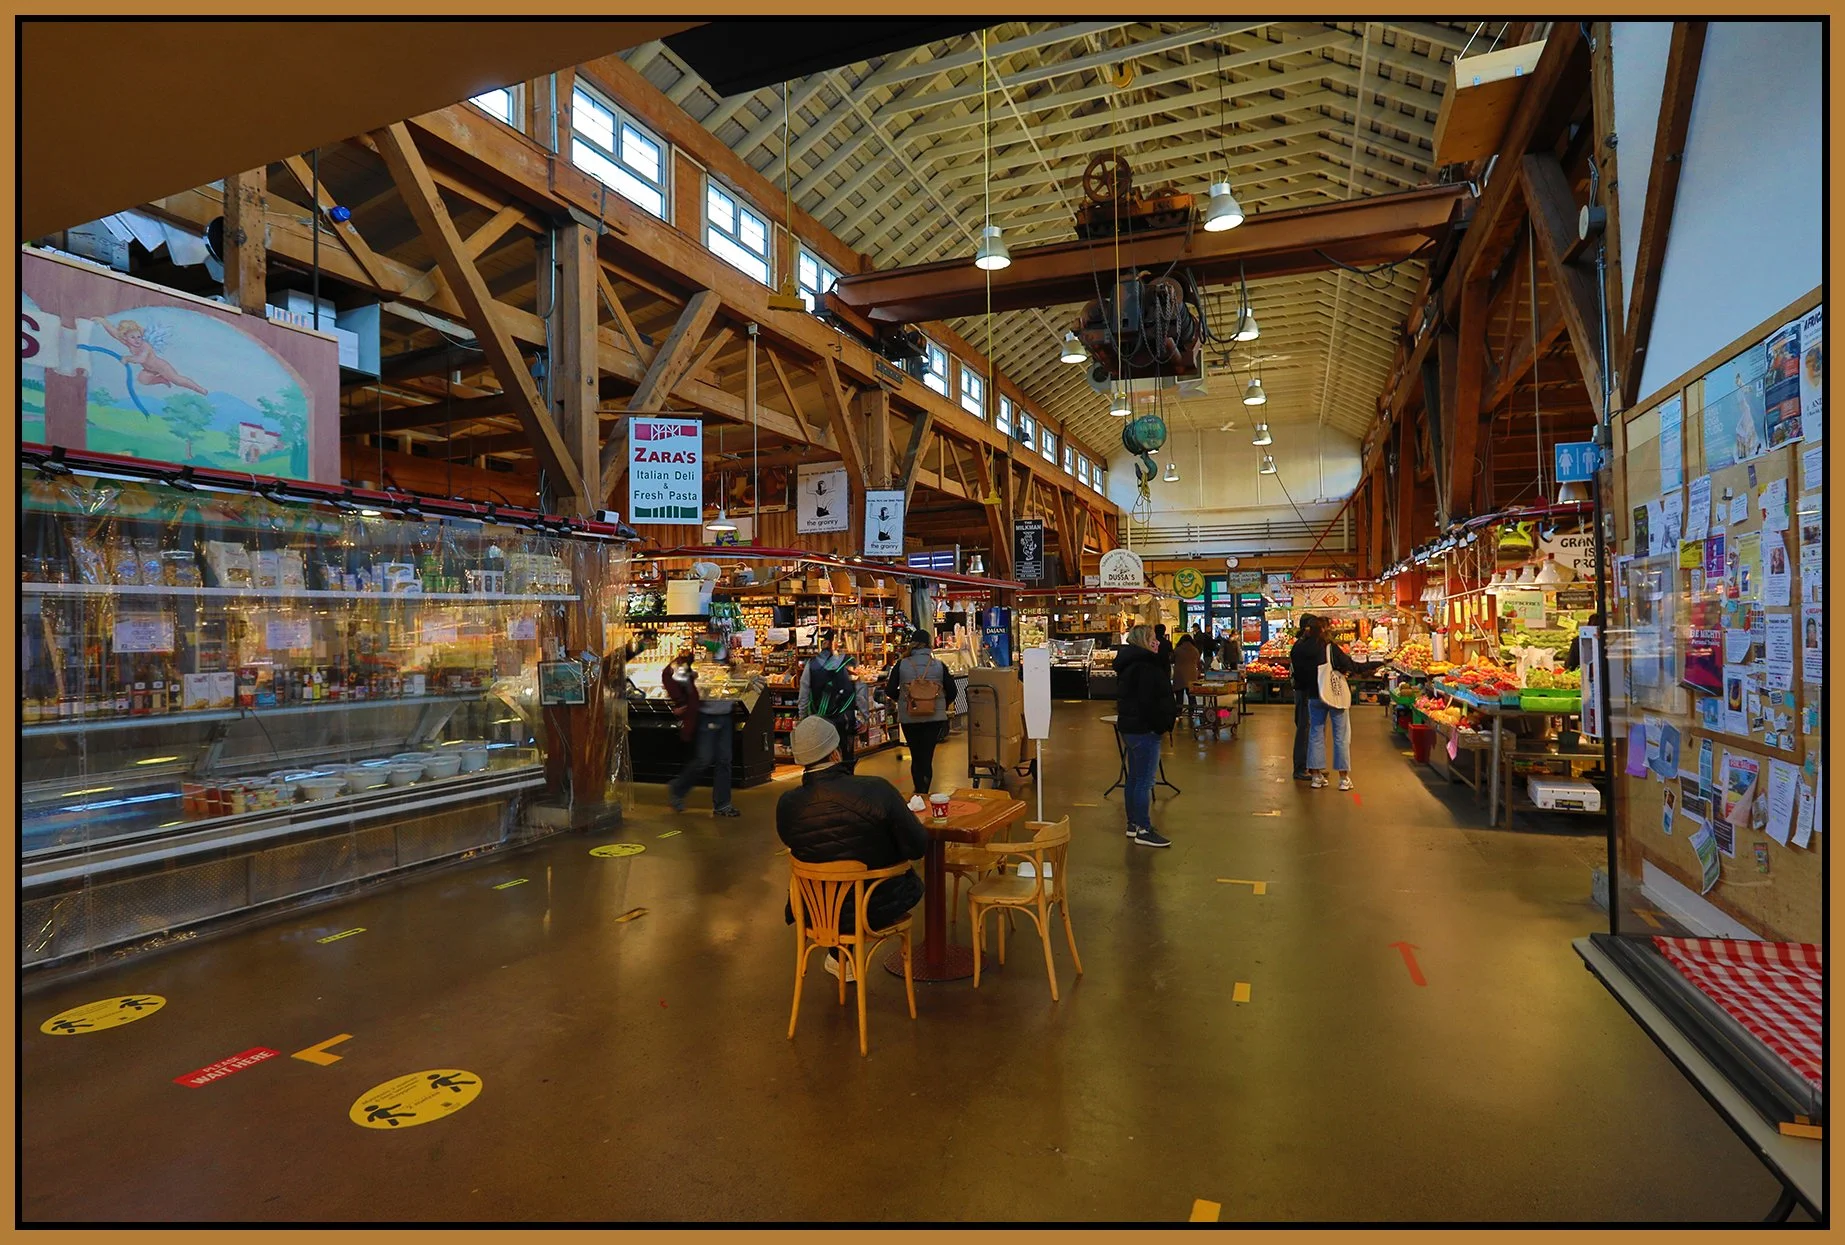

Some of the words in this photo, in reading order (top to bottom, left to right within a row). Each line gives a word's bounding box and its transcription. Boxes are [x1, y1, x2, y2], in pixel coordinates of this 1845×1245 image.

[634, 447, 697, 464] ZARA'S
[636, 470, 669, 480] Italian
[674, 470, 695, 481] Deli
[633, 490, 664, 500] Fresh
[669, 490, 698, 501] Pasta
[1108, 573, 1136, 581] DUSSA'S
[1022, 607, 1051, 615] CHEESE
[986, 627, 1006, 635] DASANI
[190, 1066, 233, 1085] WAIT
[230, 1050, 275, 1069] HERE
[203, 1055, 243, 1073] PLEASE
